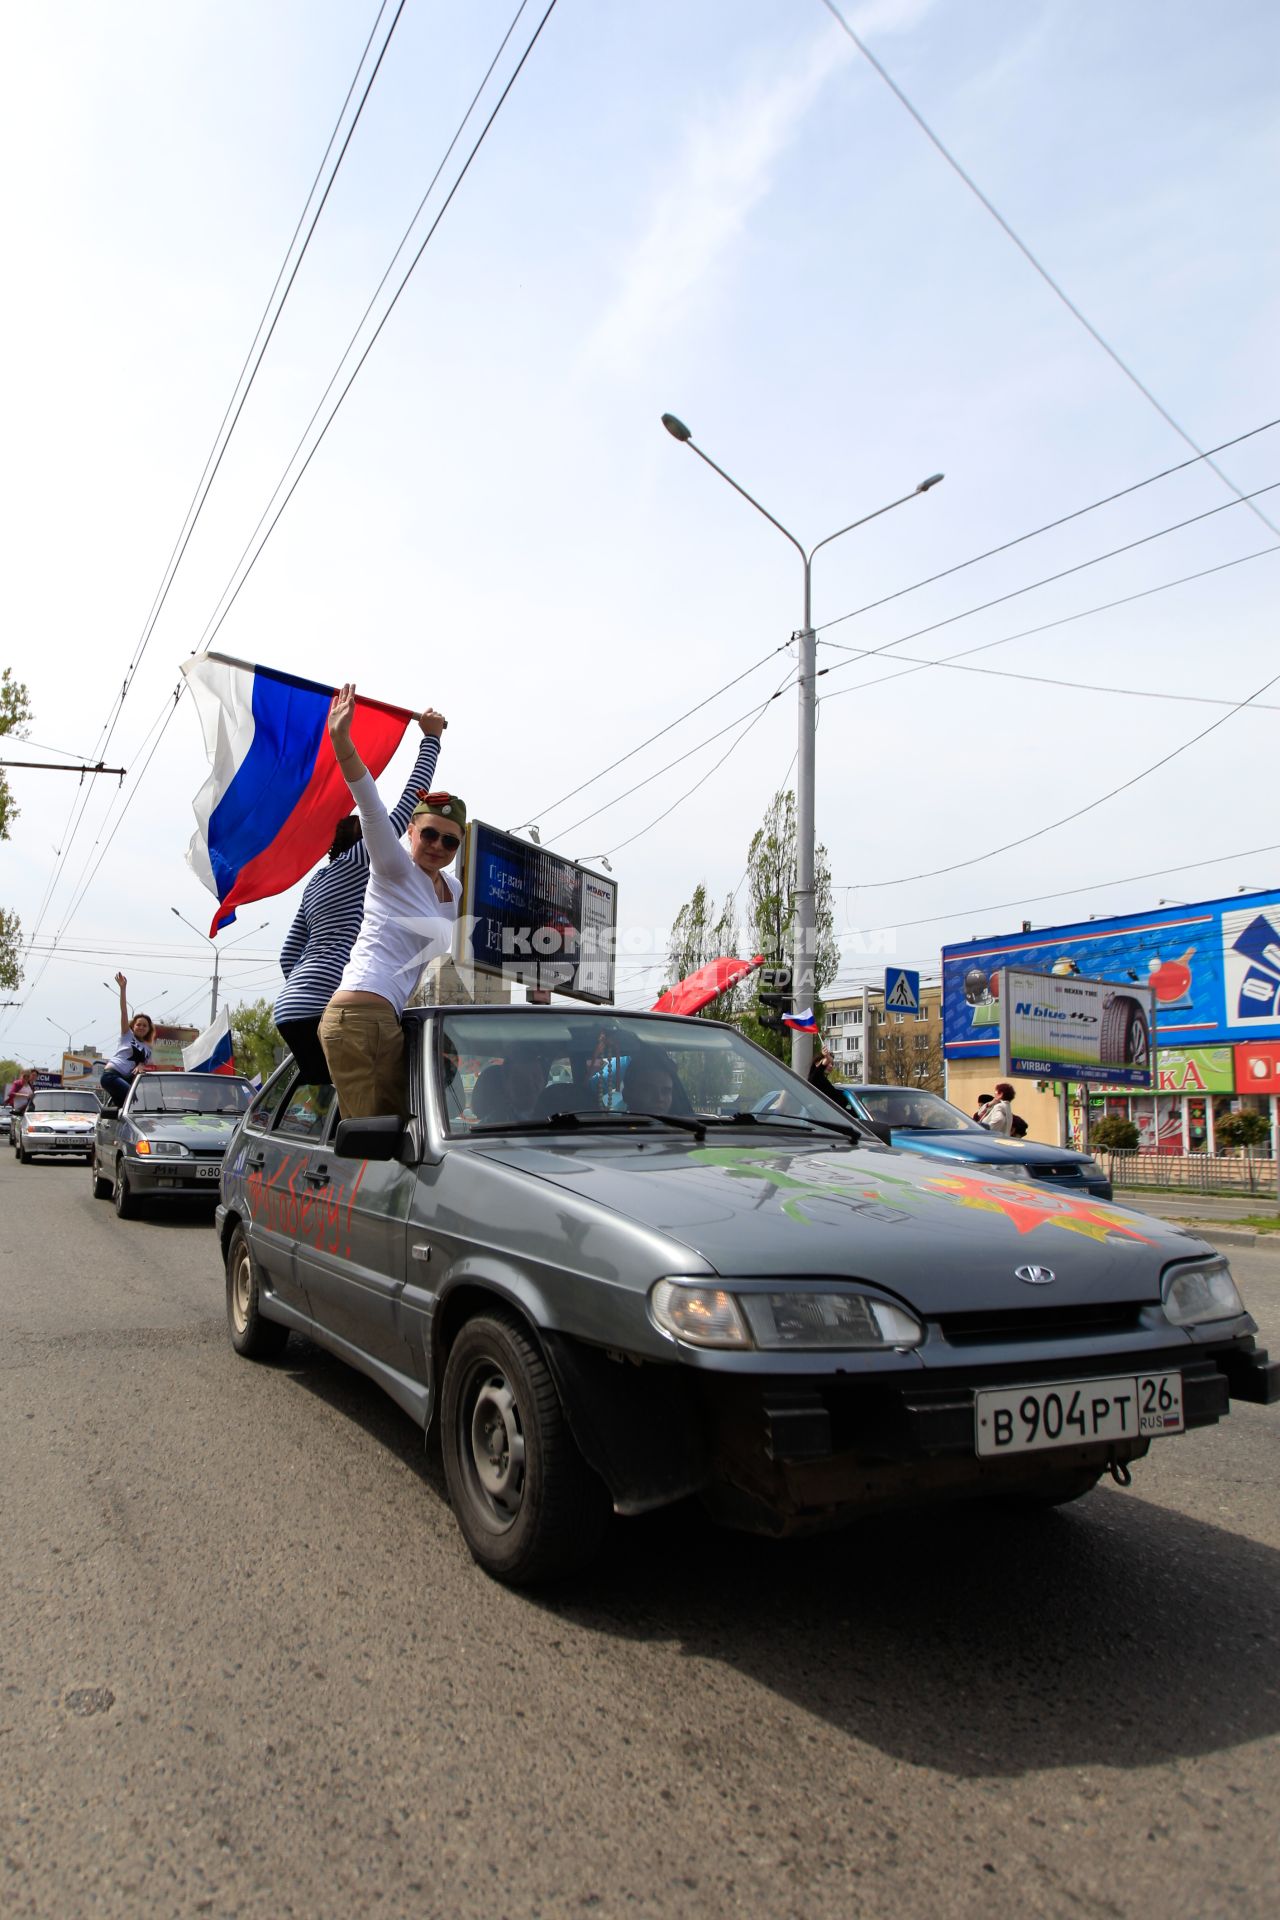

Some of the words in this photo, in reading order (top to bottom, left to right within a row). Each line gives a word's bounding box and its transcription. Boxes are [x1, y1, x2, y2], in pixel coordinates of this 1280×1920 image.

[1033, 1007, 1067, 1020] blue
[993, 1390, 1131, 1446] В904РТ
[1142, 1378, 1173, 1414] 26
[1140, 1415, 1162, 1429] RUS
